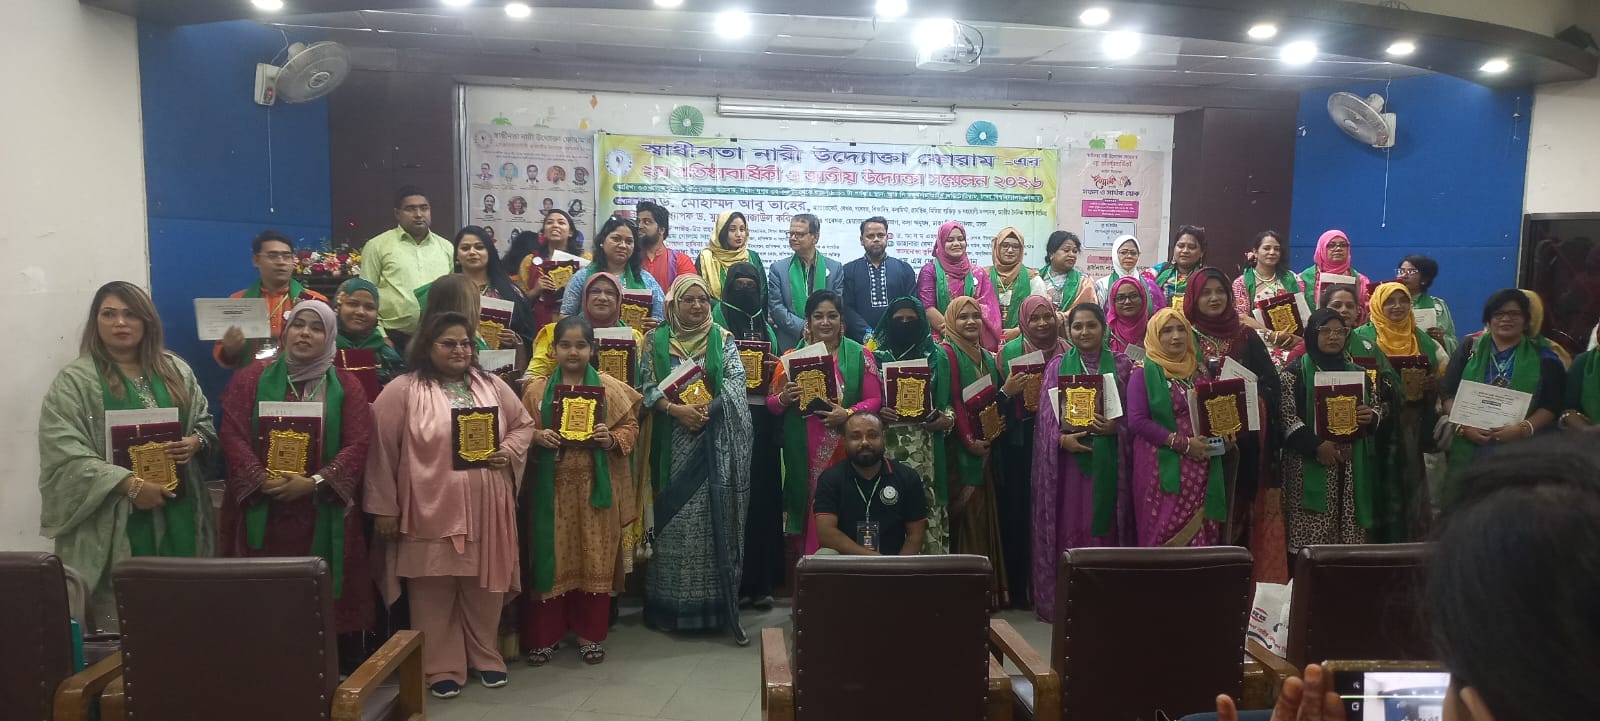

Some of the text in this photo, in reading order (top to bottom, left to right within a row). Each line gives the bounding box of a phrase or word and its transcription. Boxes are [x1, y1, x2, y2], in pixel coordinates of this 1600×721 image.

[641, 141, 743, 160] স্বাধীনতা
[753, 145, 801, 162] নারী
[812, 146, 907, 166] উদ্যোক্তা
[918, 152, 998, 168] ফোরাম
[786, 169, 799, 181] ও
[804, 167, 857, 184] জাতীয়
[862, 166, 925, 186] উদ্যোক্তা
[929, 173, 989, 188] সম্মেলন
[994, 175, 1044, 189] ২০২৬
[659, 197, 675, 208] ড.
[682, 198, 734, 208] মোহাম্মদ
[738, 199, 765, 211] আবু
[768, 200, 811, 212] তাহের,
[695, 212, 706, 221] ড.
